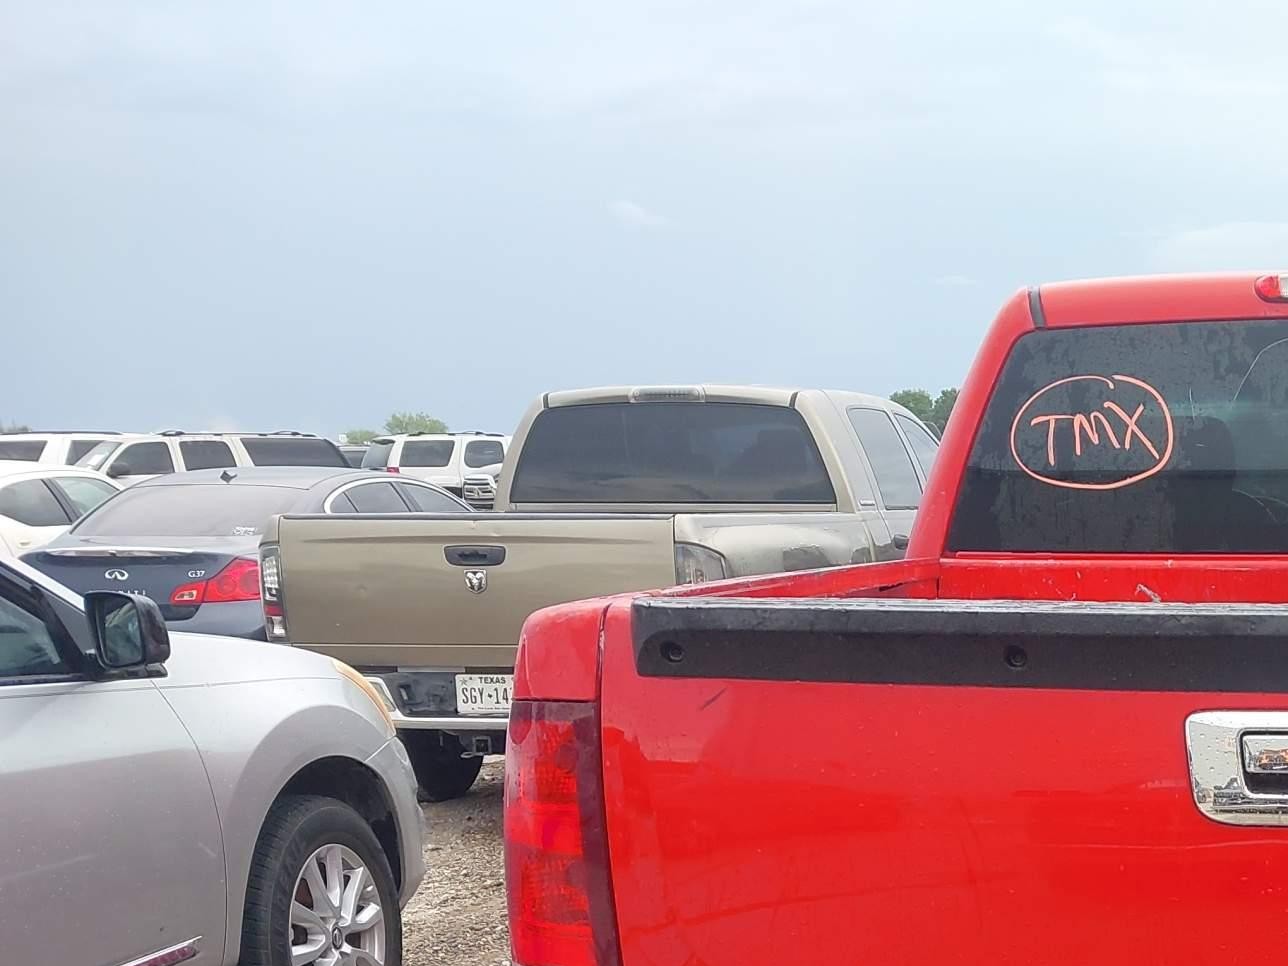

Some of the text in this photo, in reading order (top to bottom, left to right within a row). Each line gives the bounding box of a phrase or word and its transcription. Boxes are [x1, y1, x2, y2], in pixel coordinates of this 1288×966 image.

[1030, 400, 1160, 466] TMX
[478, 676, 506, 684] TEXAS
[461, 687, 484, 704] SGY
